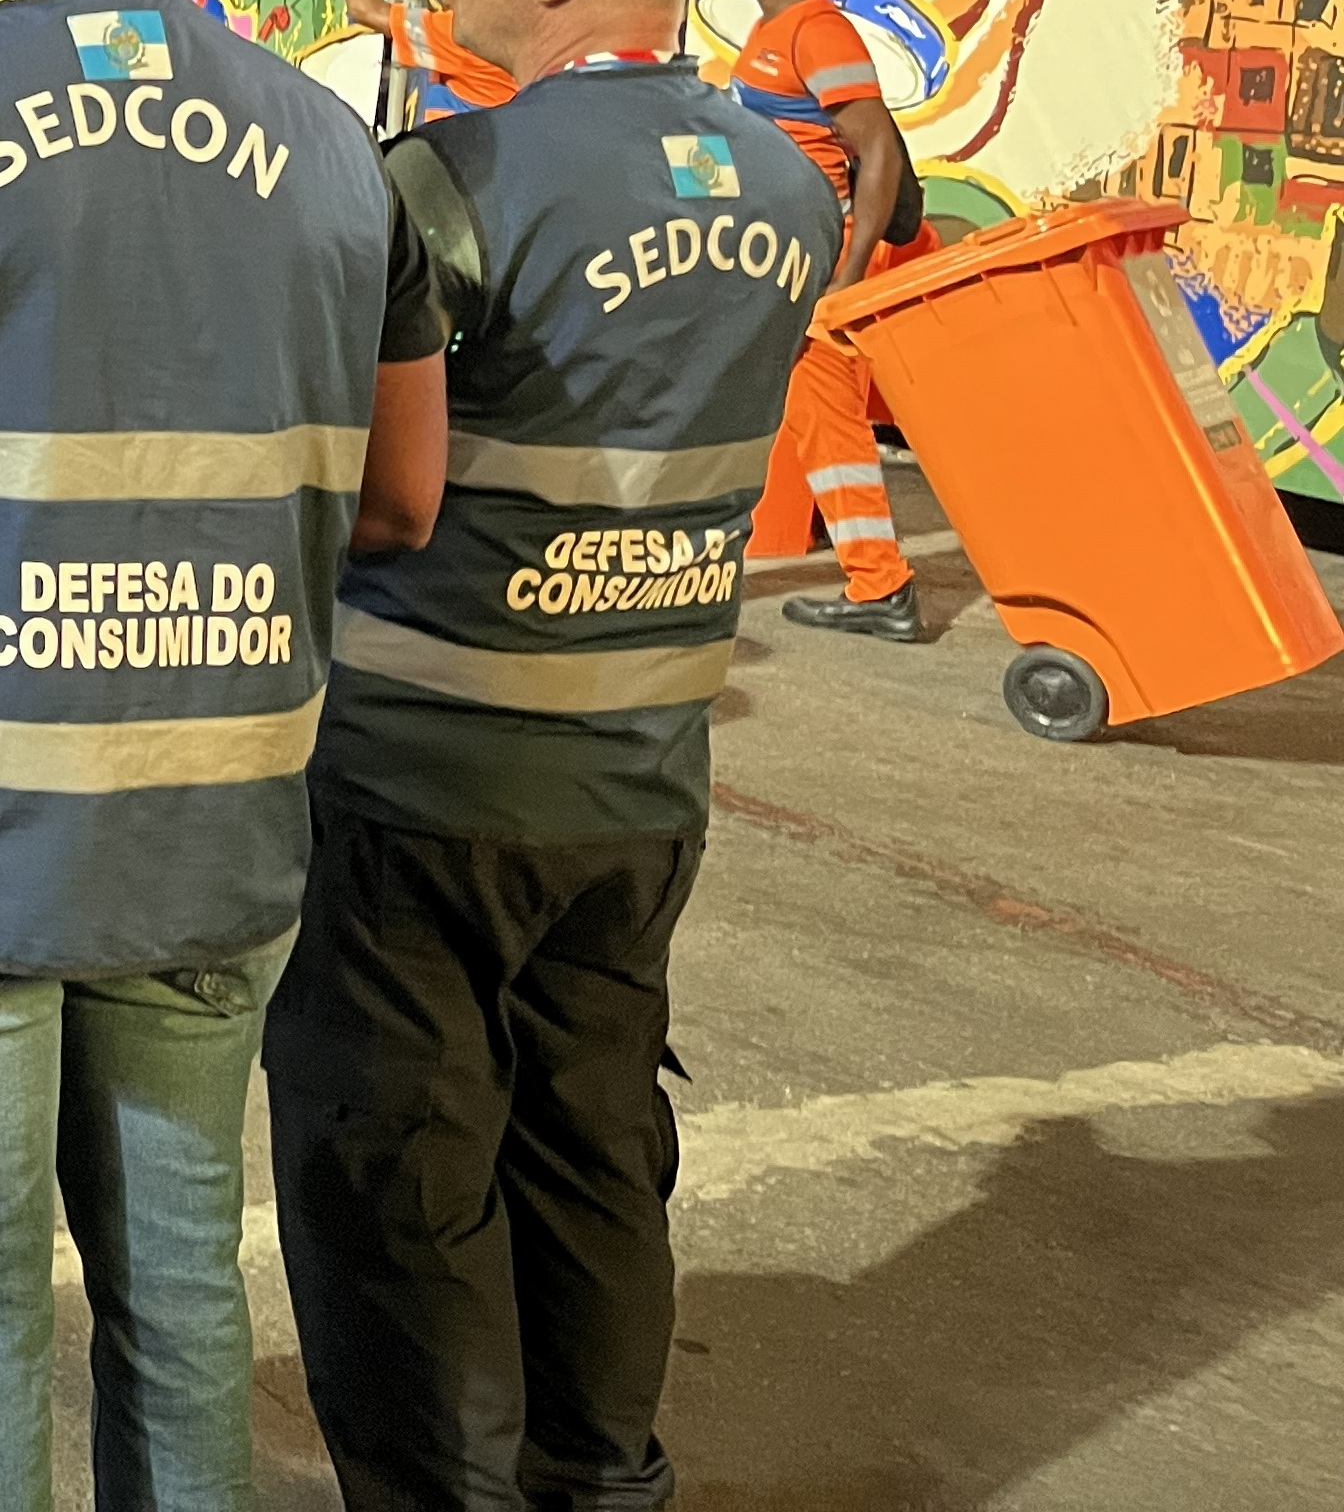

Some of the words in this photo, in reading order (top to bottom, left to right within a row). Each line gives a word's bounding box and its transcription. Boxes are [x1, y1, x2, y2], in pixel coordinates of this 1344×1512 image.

[584, 215, 811, 313] SEDCON
[544, 529, 695, 573] DEFESA
[20, 561, 199, 614] DEFESA
[211, 563, 275, 614] DO
[506, 561, 737, 615] CONSUMIDOR
